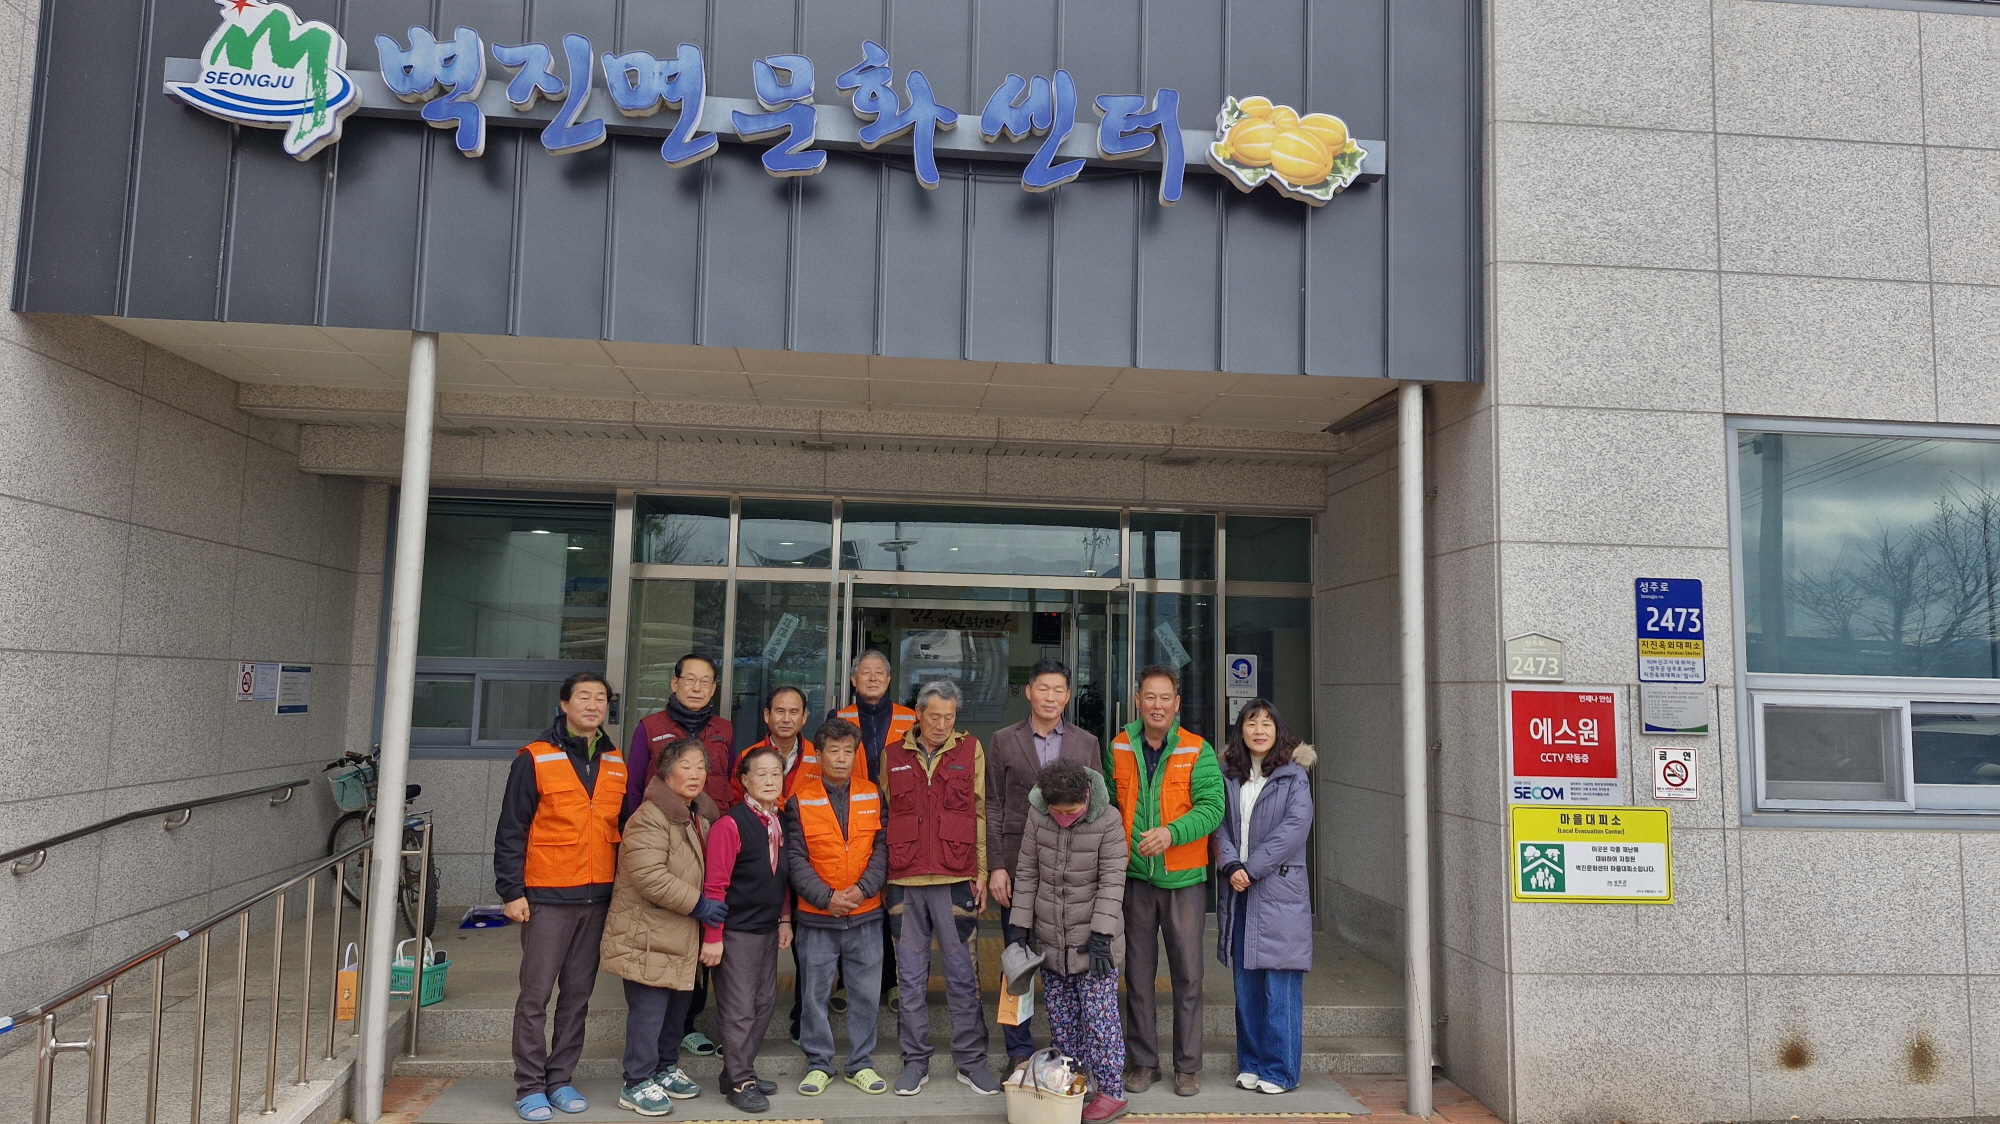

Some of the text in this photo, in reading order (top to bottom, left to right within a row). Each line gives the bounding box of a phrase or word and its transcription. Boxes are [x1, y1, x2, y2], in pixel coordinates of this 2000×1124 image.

[204, 70, 295, 89] SEONGJU
[1639, 581, 1670, 593] 성주로
[1646, 606, 1701, 633] 2473
[1641, 640, 1702, 651] 지진옥외대피소
[1511, 656, 1559, 676] 2473
[1578, 694, 1612, 704] 언제나 안심
[1529, 717, 1599, 747] 에스원
[1540, 752, 1590, 764] CCTV 작동중
[1659, 750, 1692, 762] 금 연
[1513, 786, 1564, 801] SECOM
[1560, 813, 1622, 826] 마을대피소
